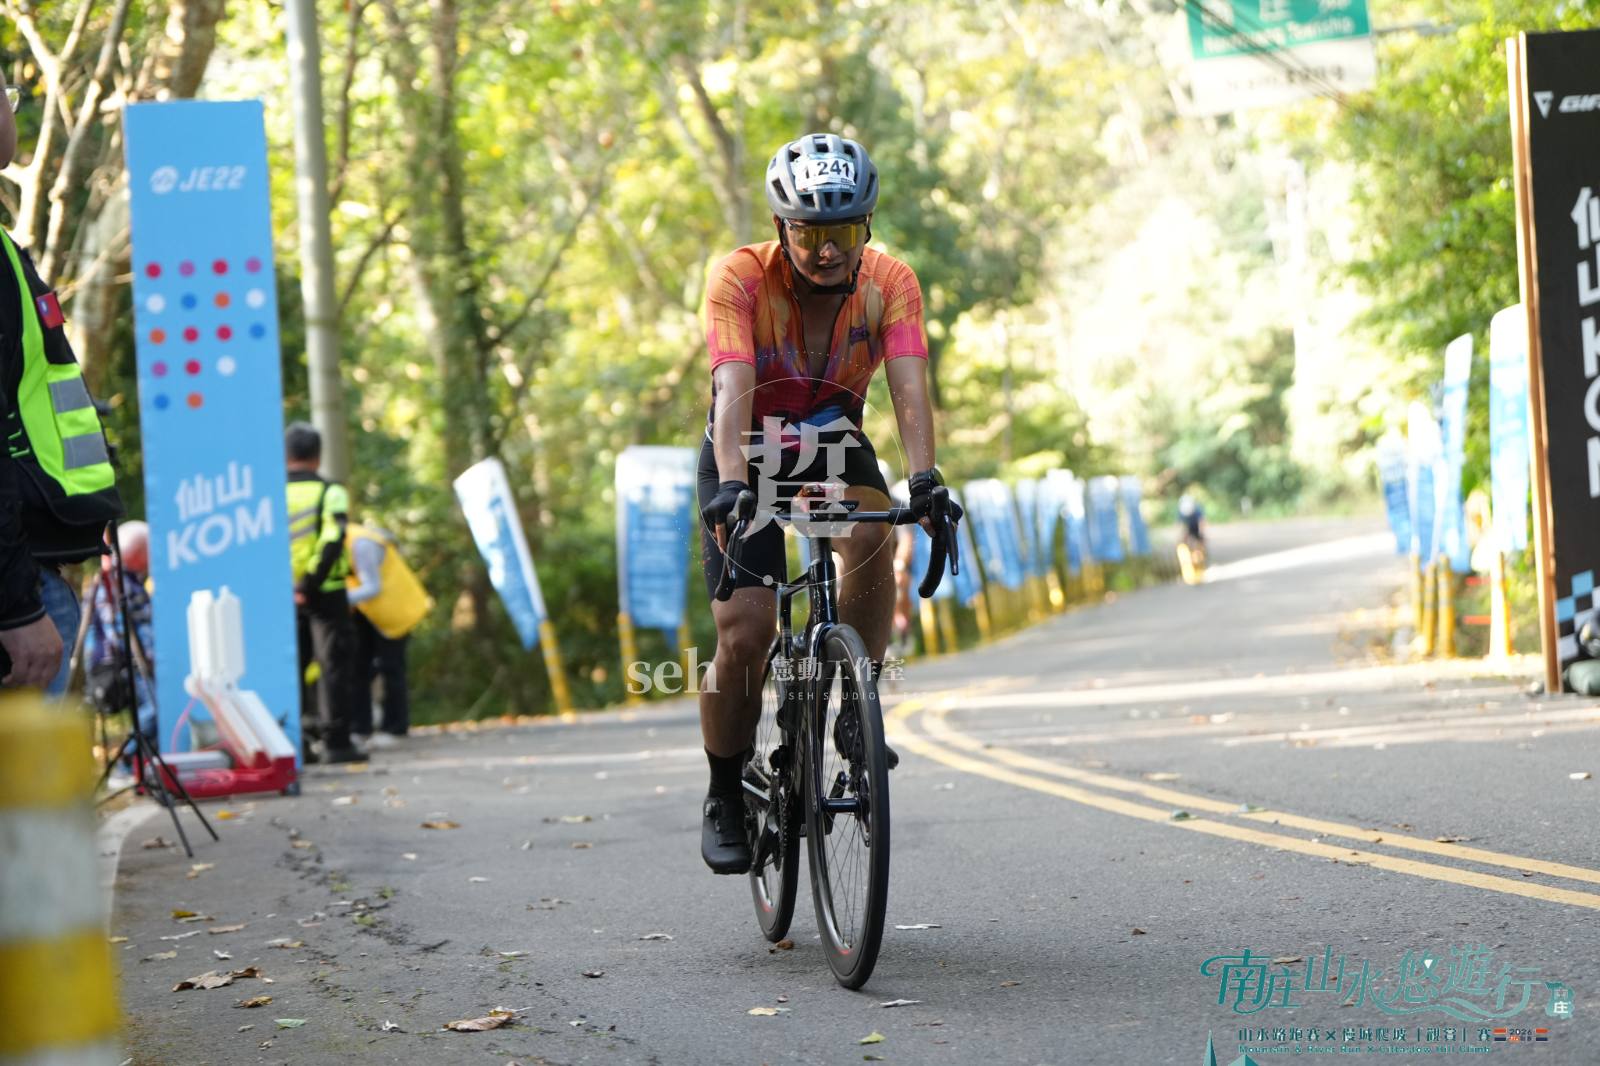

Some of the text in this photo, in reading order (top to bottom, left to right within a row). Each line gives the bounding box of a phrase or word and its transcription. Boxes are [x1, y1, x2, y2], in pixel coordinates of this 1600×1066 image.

[179, 165, 247, 191] JE22
[175, 460, 253, 522] 仙山
[167, 496, 273, 571] KOM
